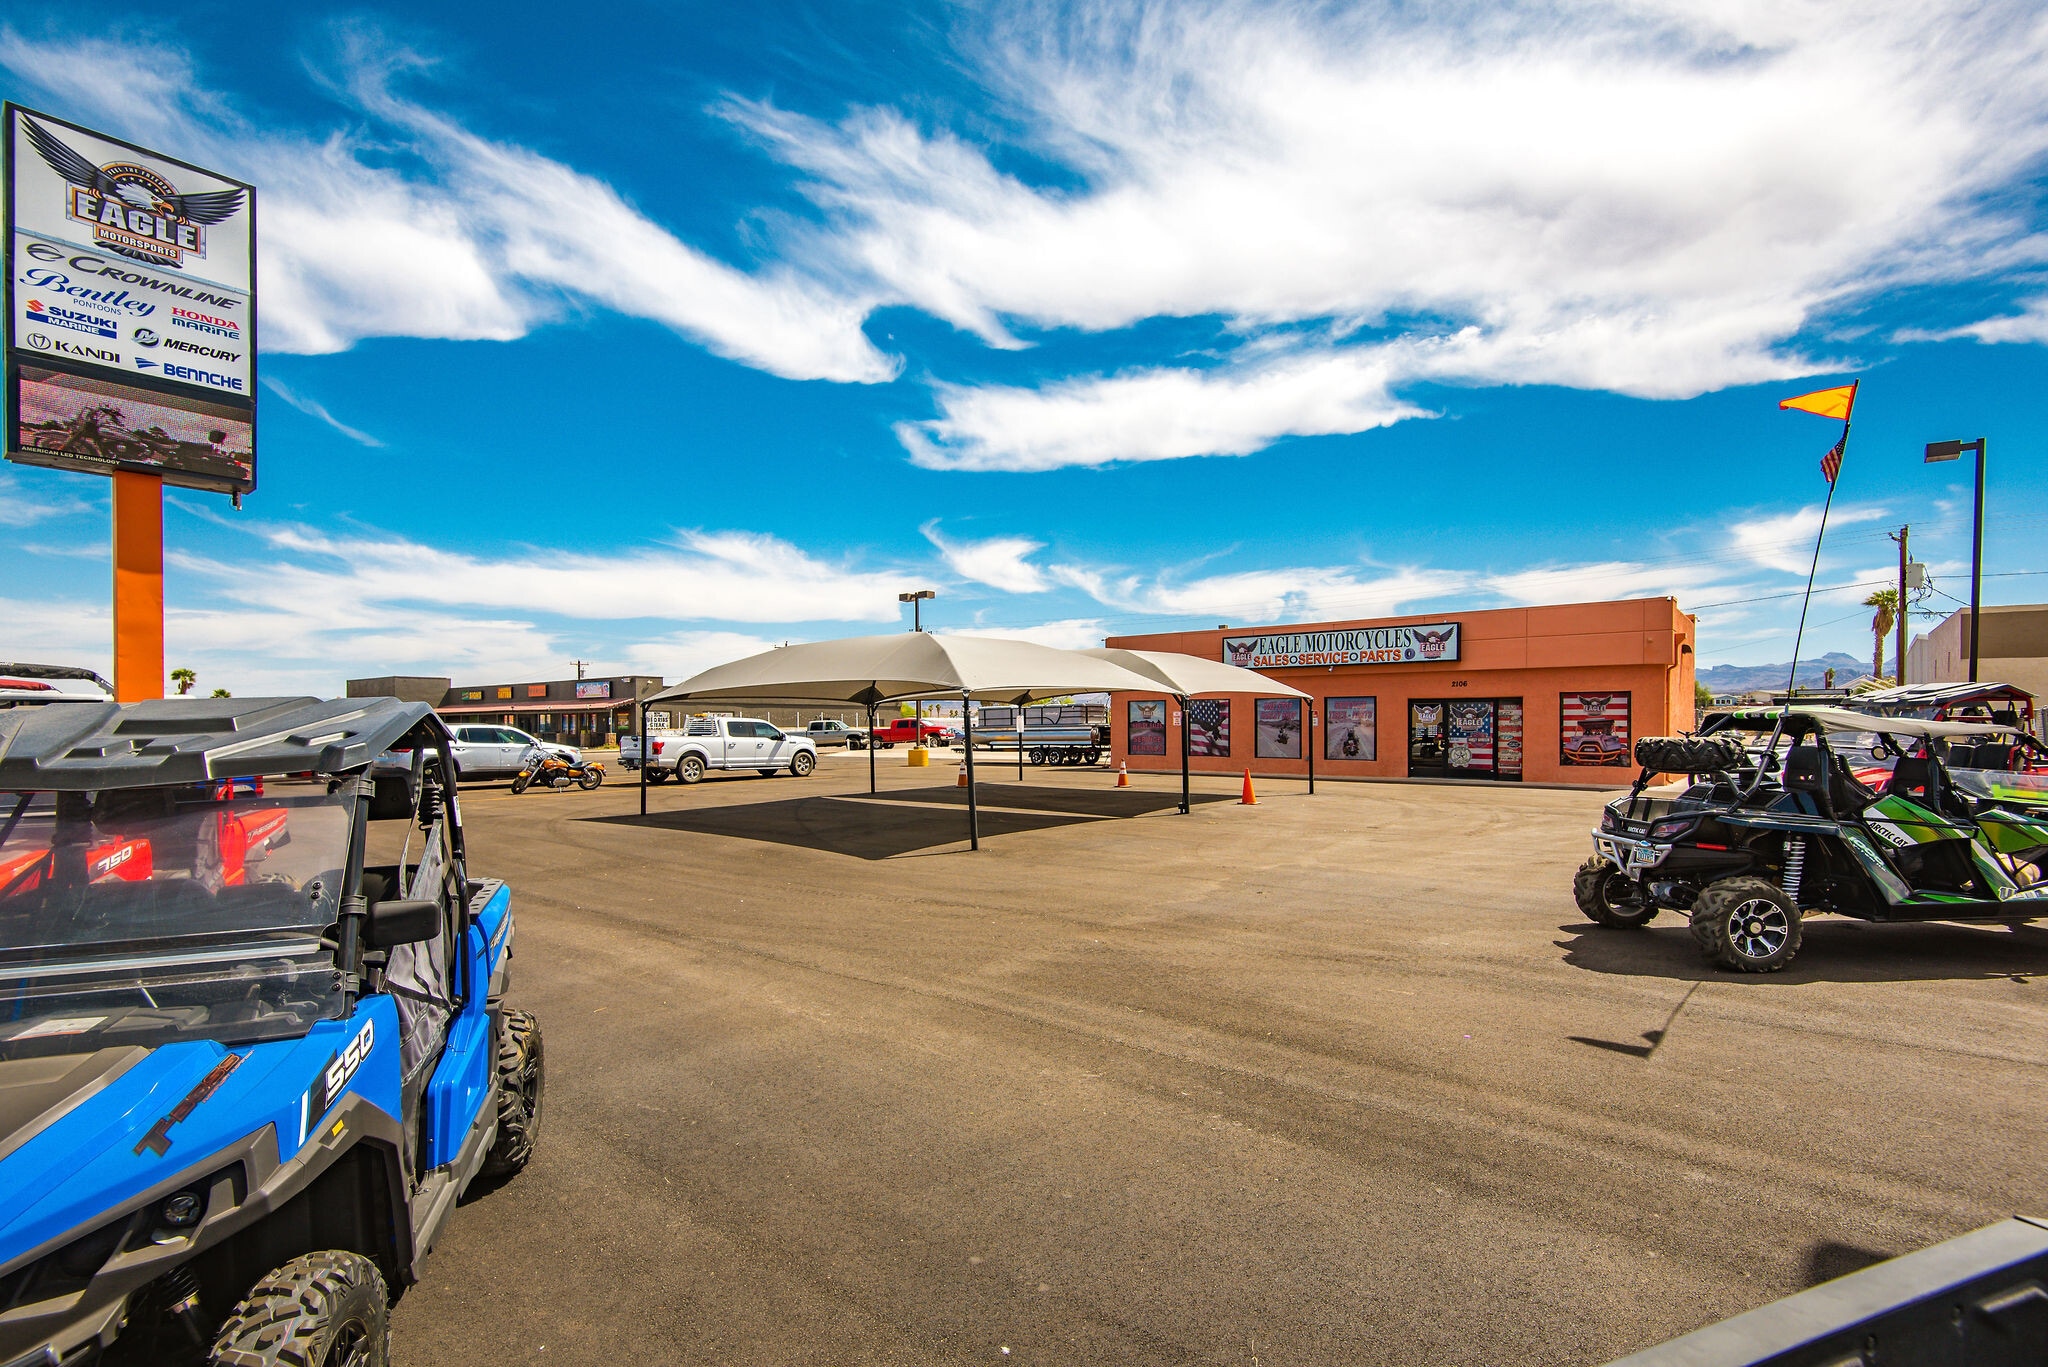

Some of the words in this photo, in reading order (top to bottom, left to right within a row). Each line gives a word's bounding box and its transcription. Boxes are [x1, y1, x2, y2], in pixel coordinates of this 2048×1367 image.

[76, 190, 197, 250] EAGLE
[99, 228, 177, 258] MOTORSPORTS
[19, 268, 156, 317] Bentley
[68, 256, 241, 310] CROWNLINE
[48, 306, 117, 330] SUZUKI
[73, 298, 122, 316] PONTOONS
[171, 306, 240, 330] HONDA
[48, 316, 100, 335] MARINE
[55, 340, 120, 363] KANDI
[164, 338, 241, 363] MERCURY
[164, 363, 242, 390] BENNCHE
[21, 446, 59, 456] AMERICAN
[75, 454, 120, 465] TECHNOLOGY
[1259, 634, 1302, 655] EAGLE
[1304, 628, 1412, 653] MOTORCYCLES
[1421, 643, 1445, 652] EAGLE
[1233, 653, 1251, 661] EAGLE
[1253, 655, 1290, 667] SALES
[1298, 651, 1349, 666] SERVICE
[1360, 649, 1402, 662] PARTS
[1869, 822, 1895, 840] ARCTIC
[1892, 836, 1909, 848] CAT
[97, 845, 132, 874] 750
[326, 1017, 375, 1110] 550
